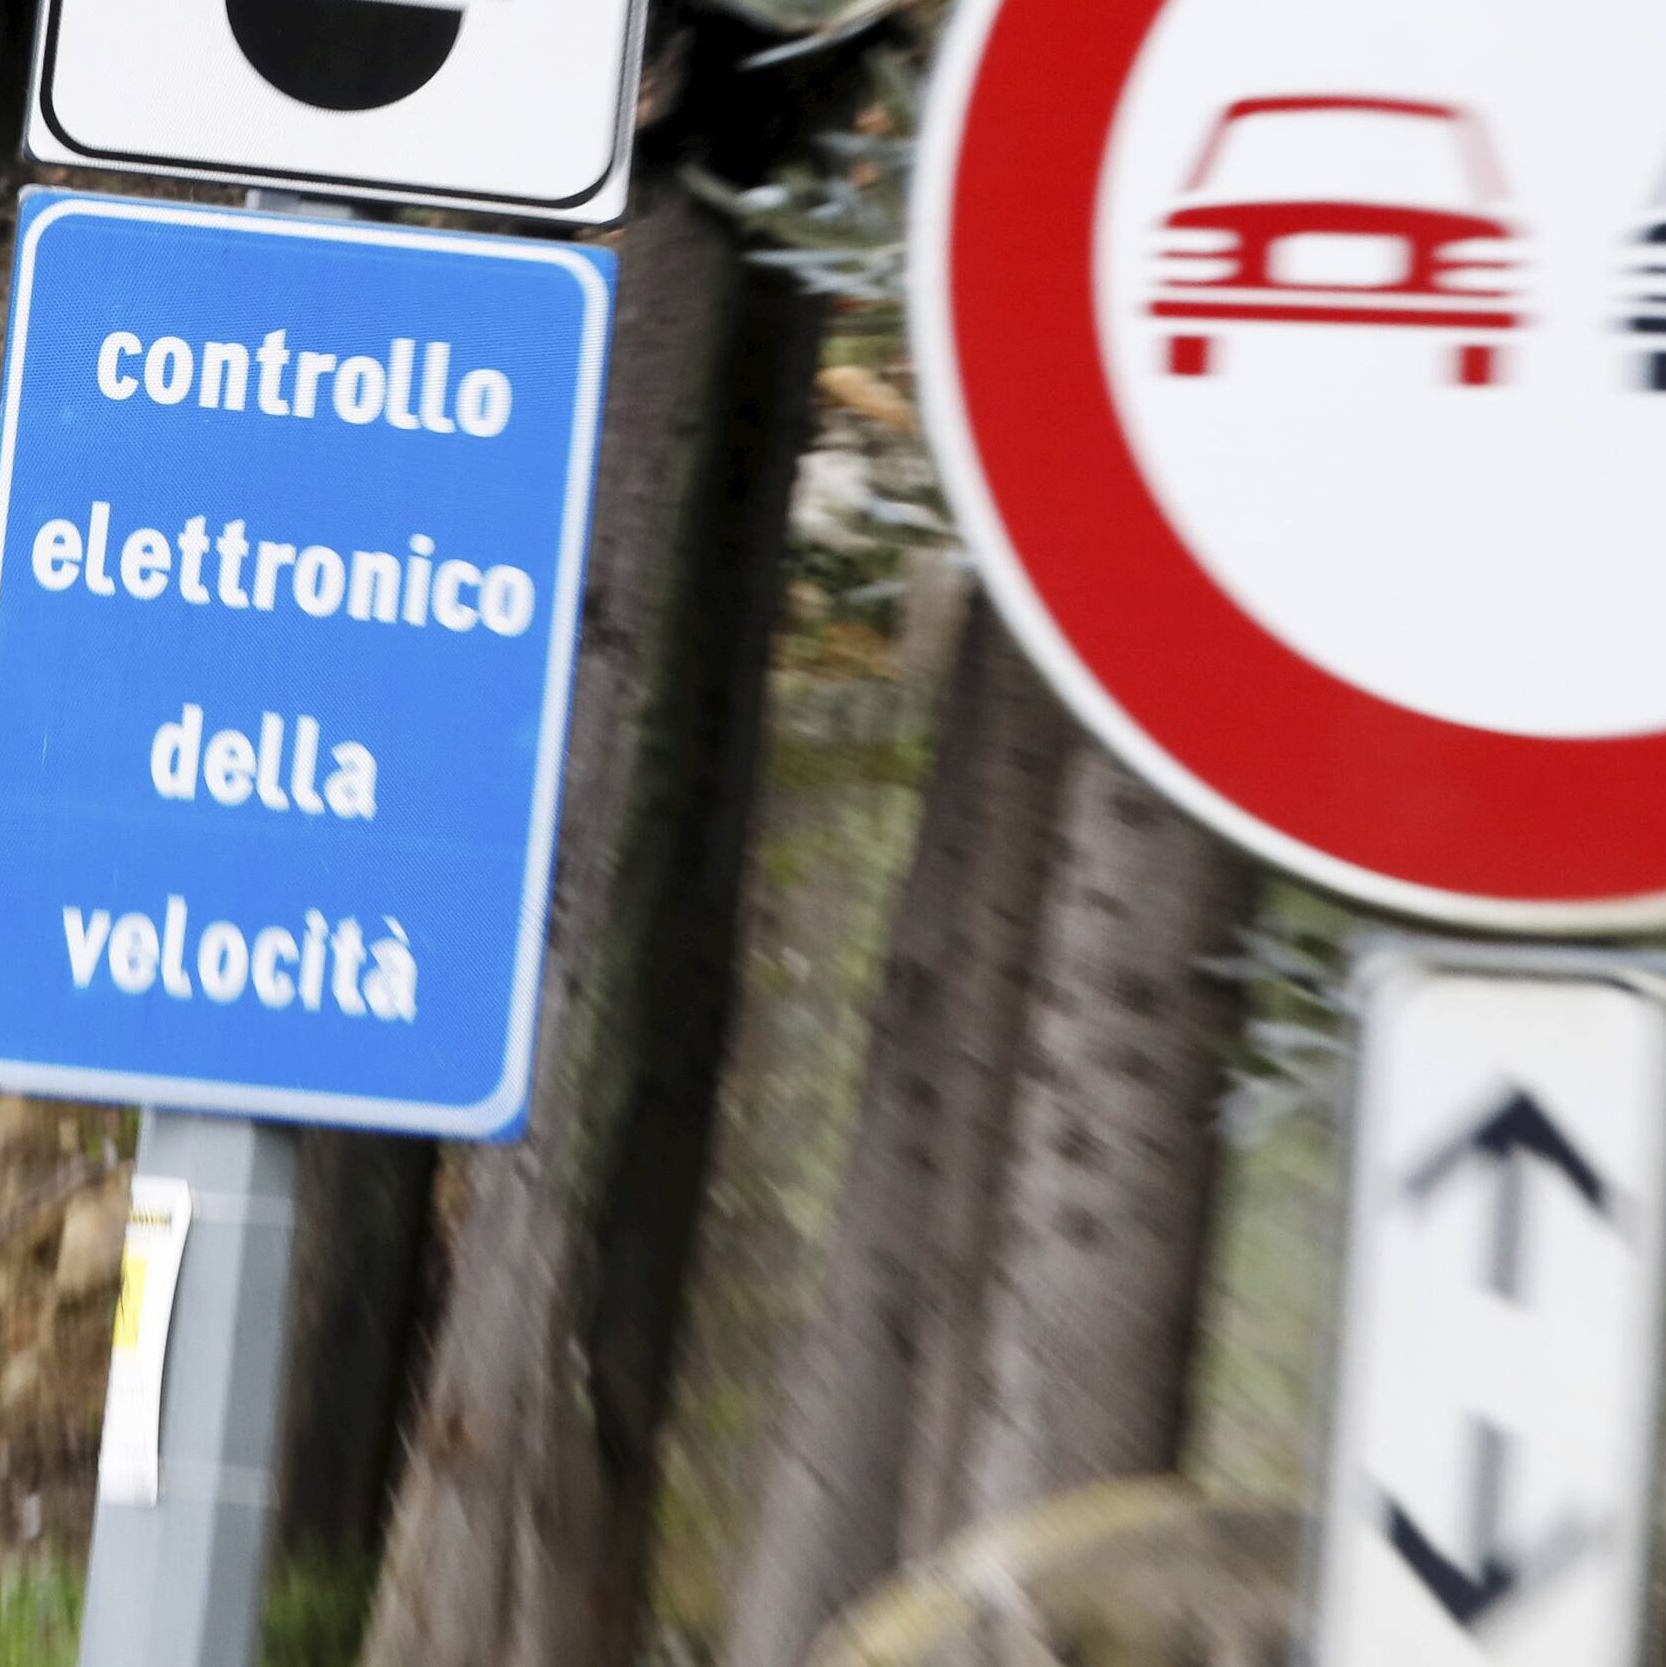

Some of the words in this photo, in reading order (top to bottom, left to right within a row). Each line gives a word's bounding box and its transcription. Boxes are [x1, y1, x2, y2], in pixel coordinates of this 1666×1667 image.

[96, 326, 514, 439] controllo
[31, 501, 536, 639] elettronico
[150, 703, 378, 821] della
[62, 895, 419, 1024] velocità
